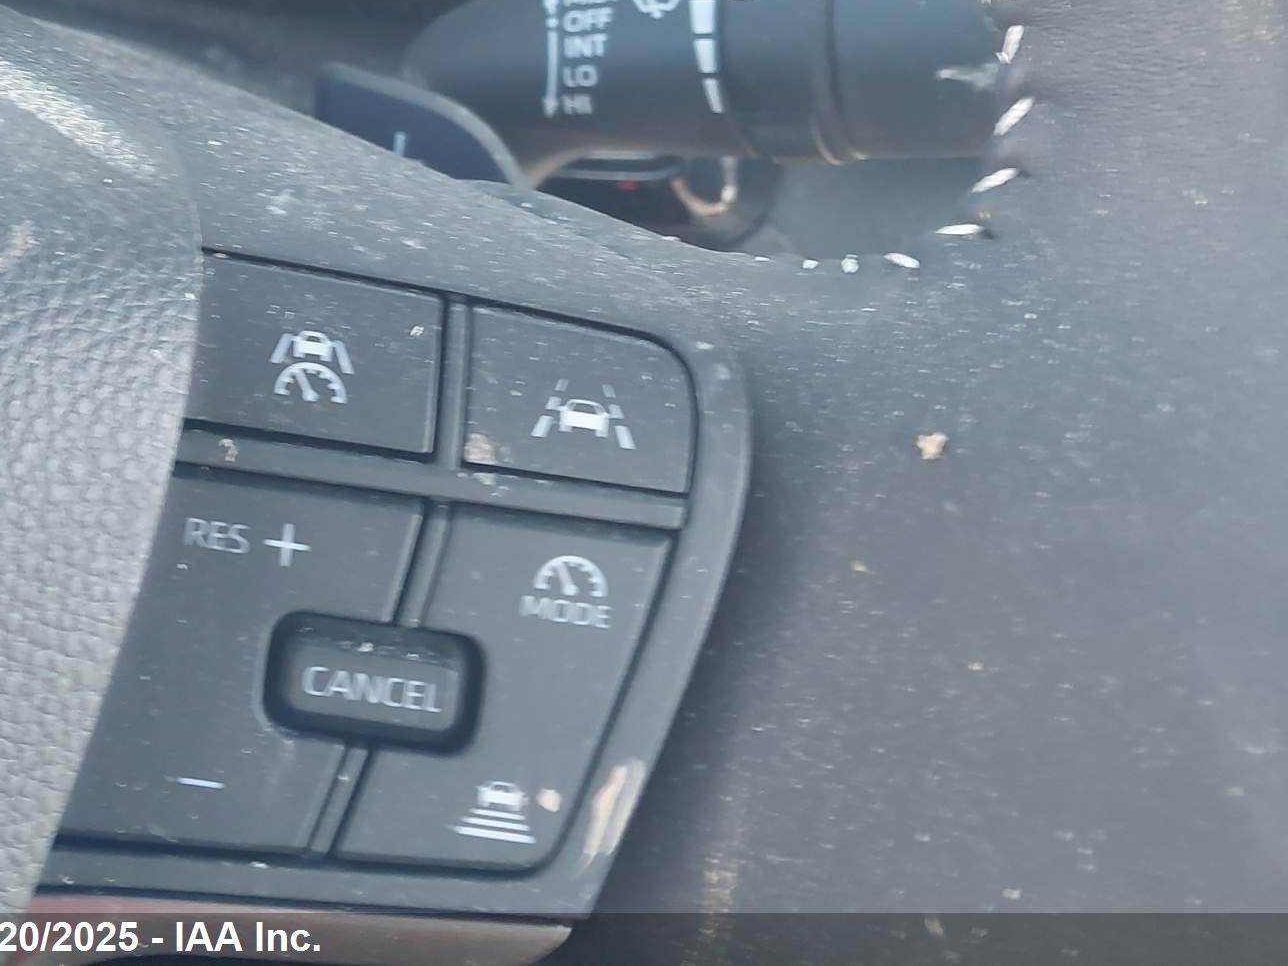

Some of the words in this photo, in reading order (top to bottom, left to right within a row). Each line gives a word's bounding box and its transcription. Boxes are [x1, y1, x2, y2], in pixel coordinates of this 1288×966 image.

[563, 8, 612, 32] OFF
[563, 34, 607, 58] INT
[563, 65, 598, 88] LO
[563, 93, 593, 114] HI
[184, 517, 250, 554] RES
[520, 594, 610, 629] MODE
[302, 665, 442, 714] CANCEL
